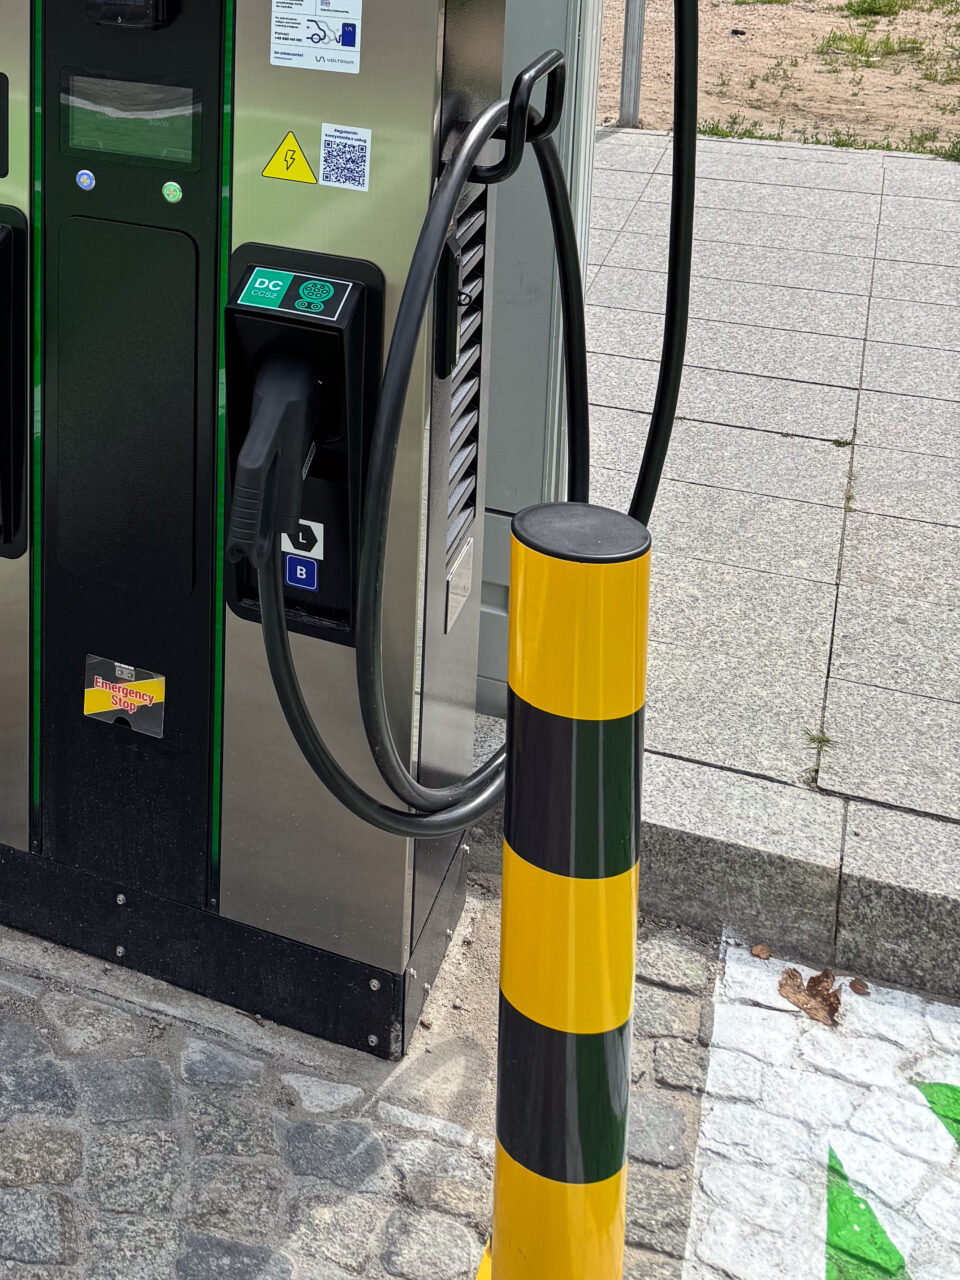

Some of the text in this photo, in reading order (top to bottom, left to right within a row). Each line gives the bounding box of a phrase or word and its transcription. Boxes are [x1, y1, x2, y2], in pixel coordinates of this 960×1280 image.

[254, 278, 283, 291] DC
[251, 289, 278, 299] CCS2
[298, 532, 307, 543] L
[296, 565, 307, 579] B
[94, 675, 155, 706] Emergency
[111, 694, 137, 714] Stop
